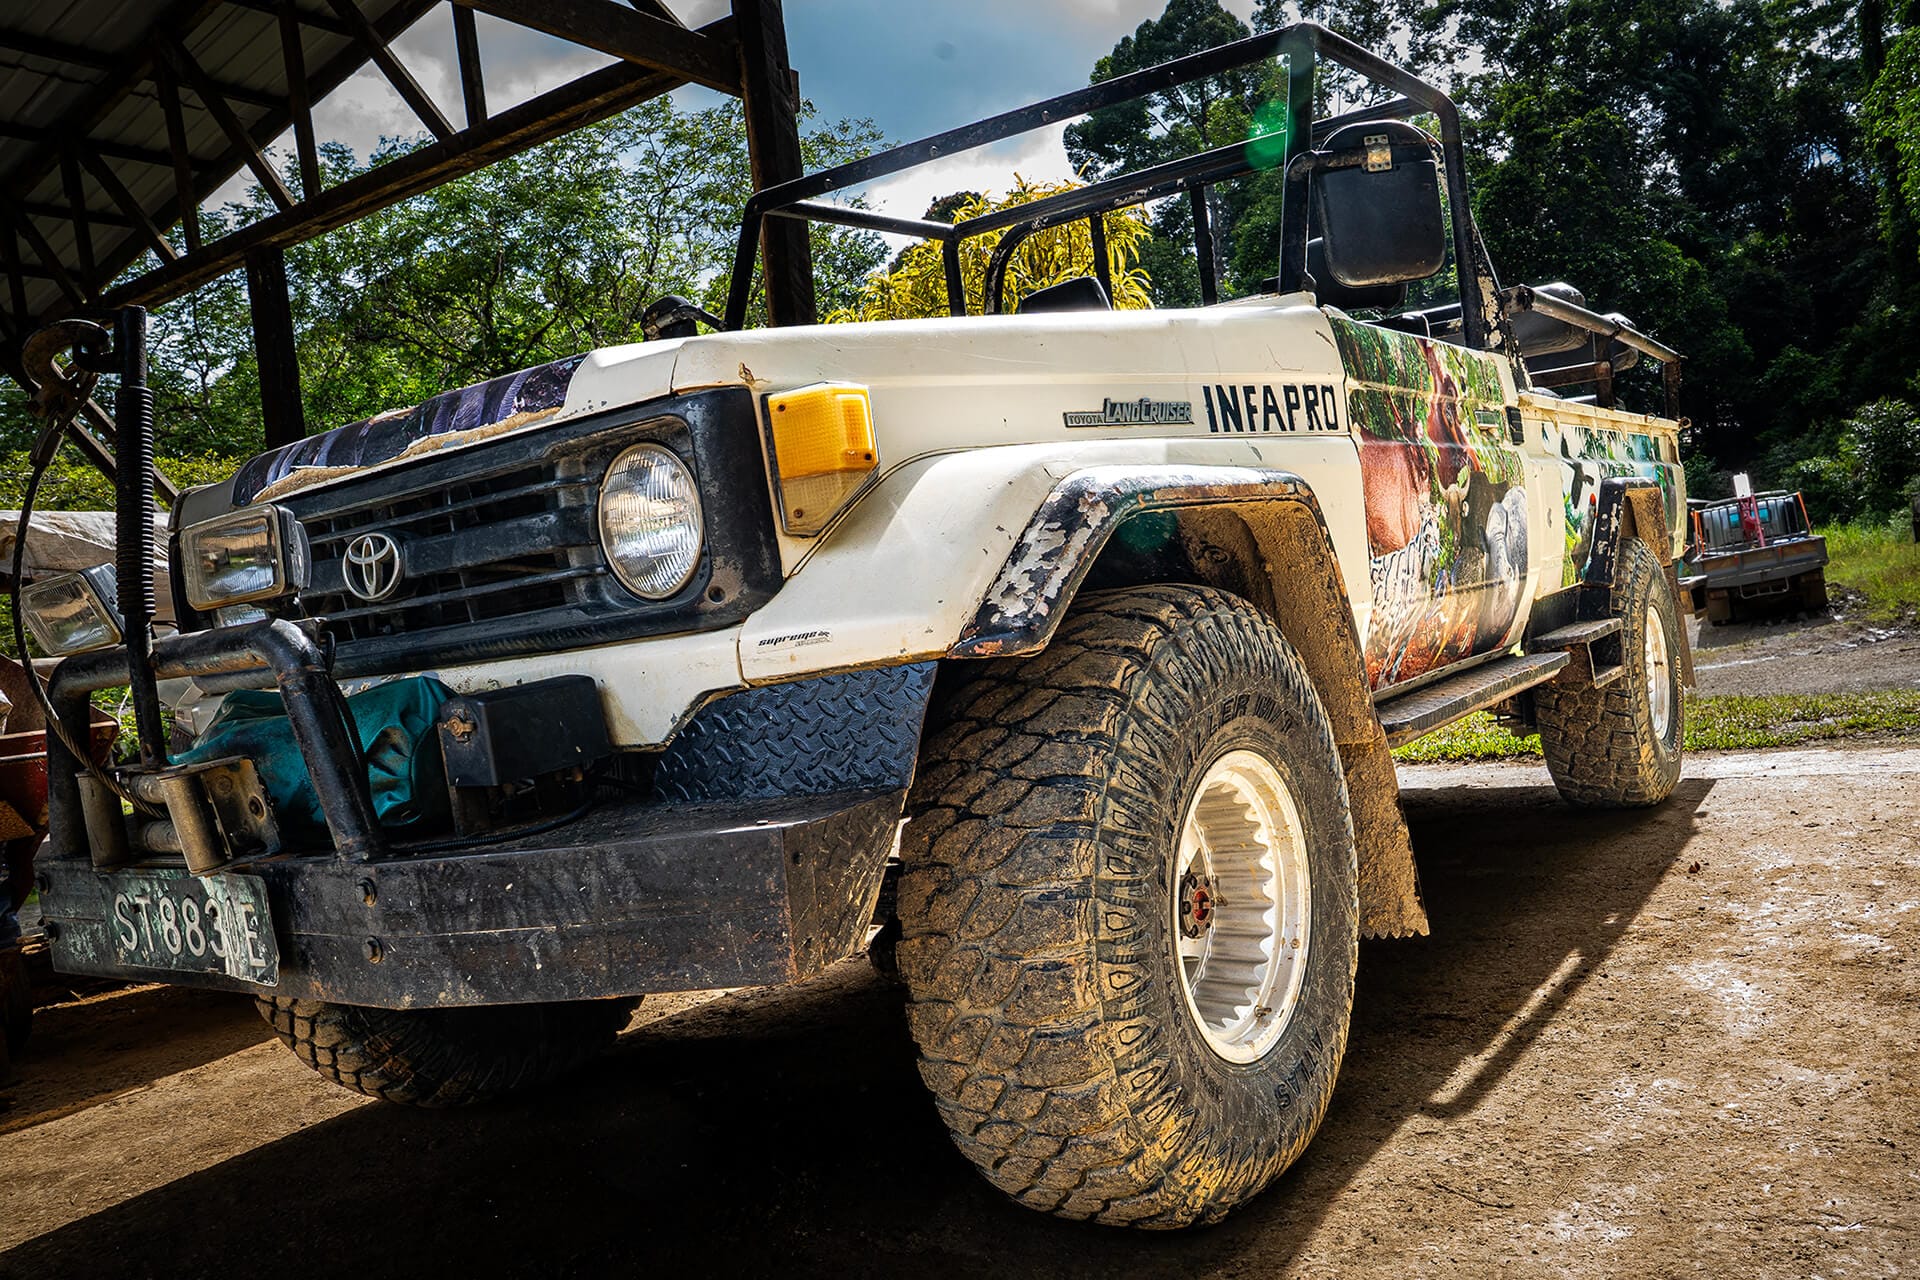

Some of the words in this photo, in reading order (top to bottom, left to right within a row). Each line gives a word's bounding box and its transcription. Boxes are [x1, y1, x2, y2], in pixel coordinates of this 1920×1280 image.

[1202, 384, 1340, 432] INFAPRO
[1067, 412, 1103, 426] TOYOTA
[758, 631, 817, 646] supreme
